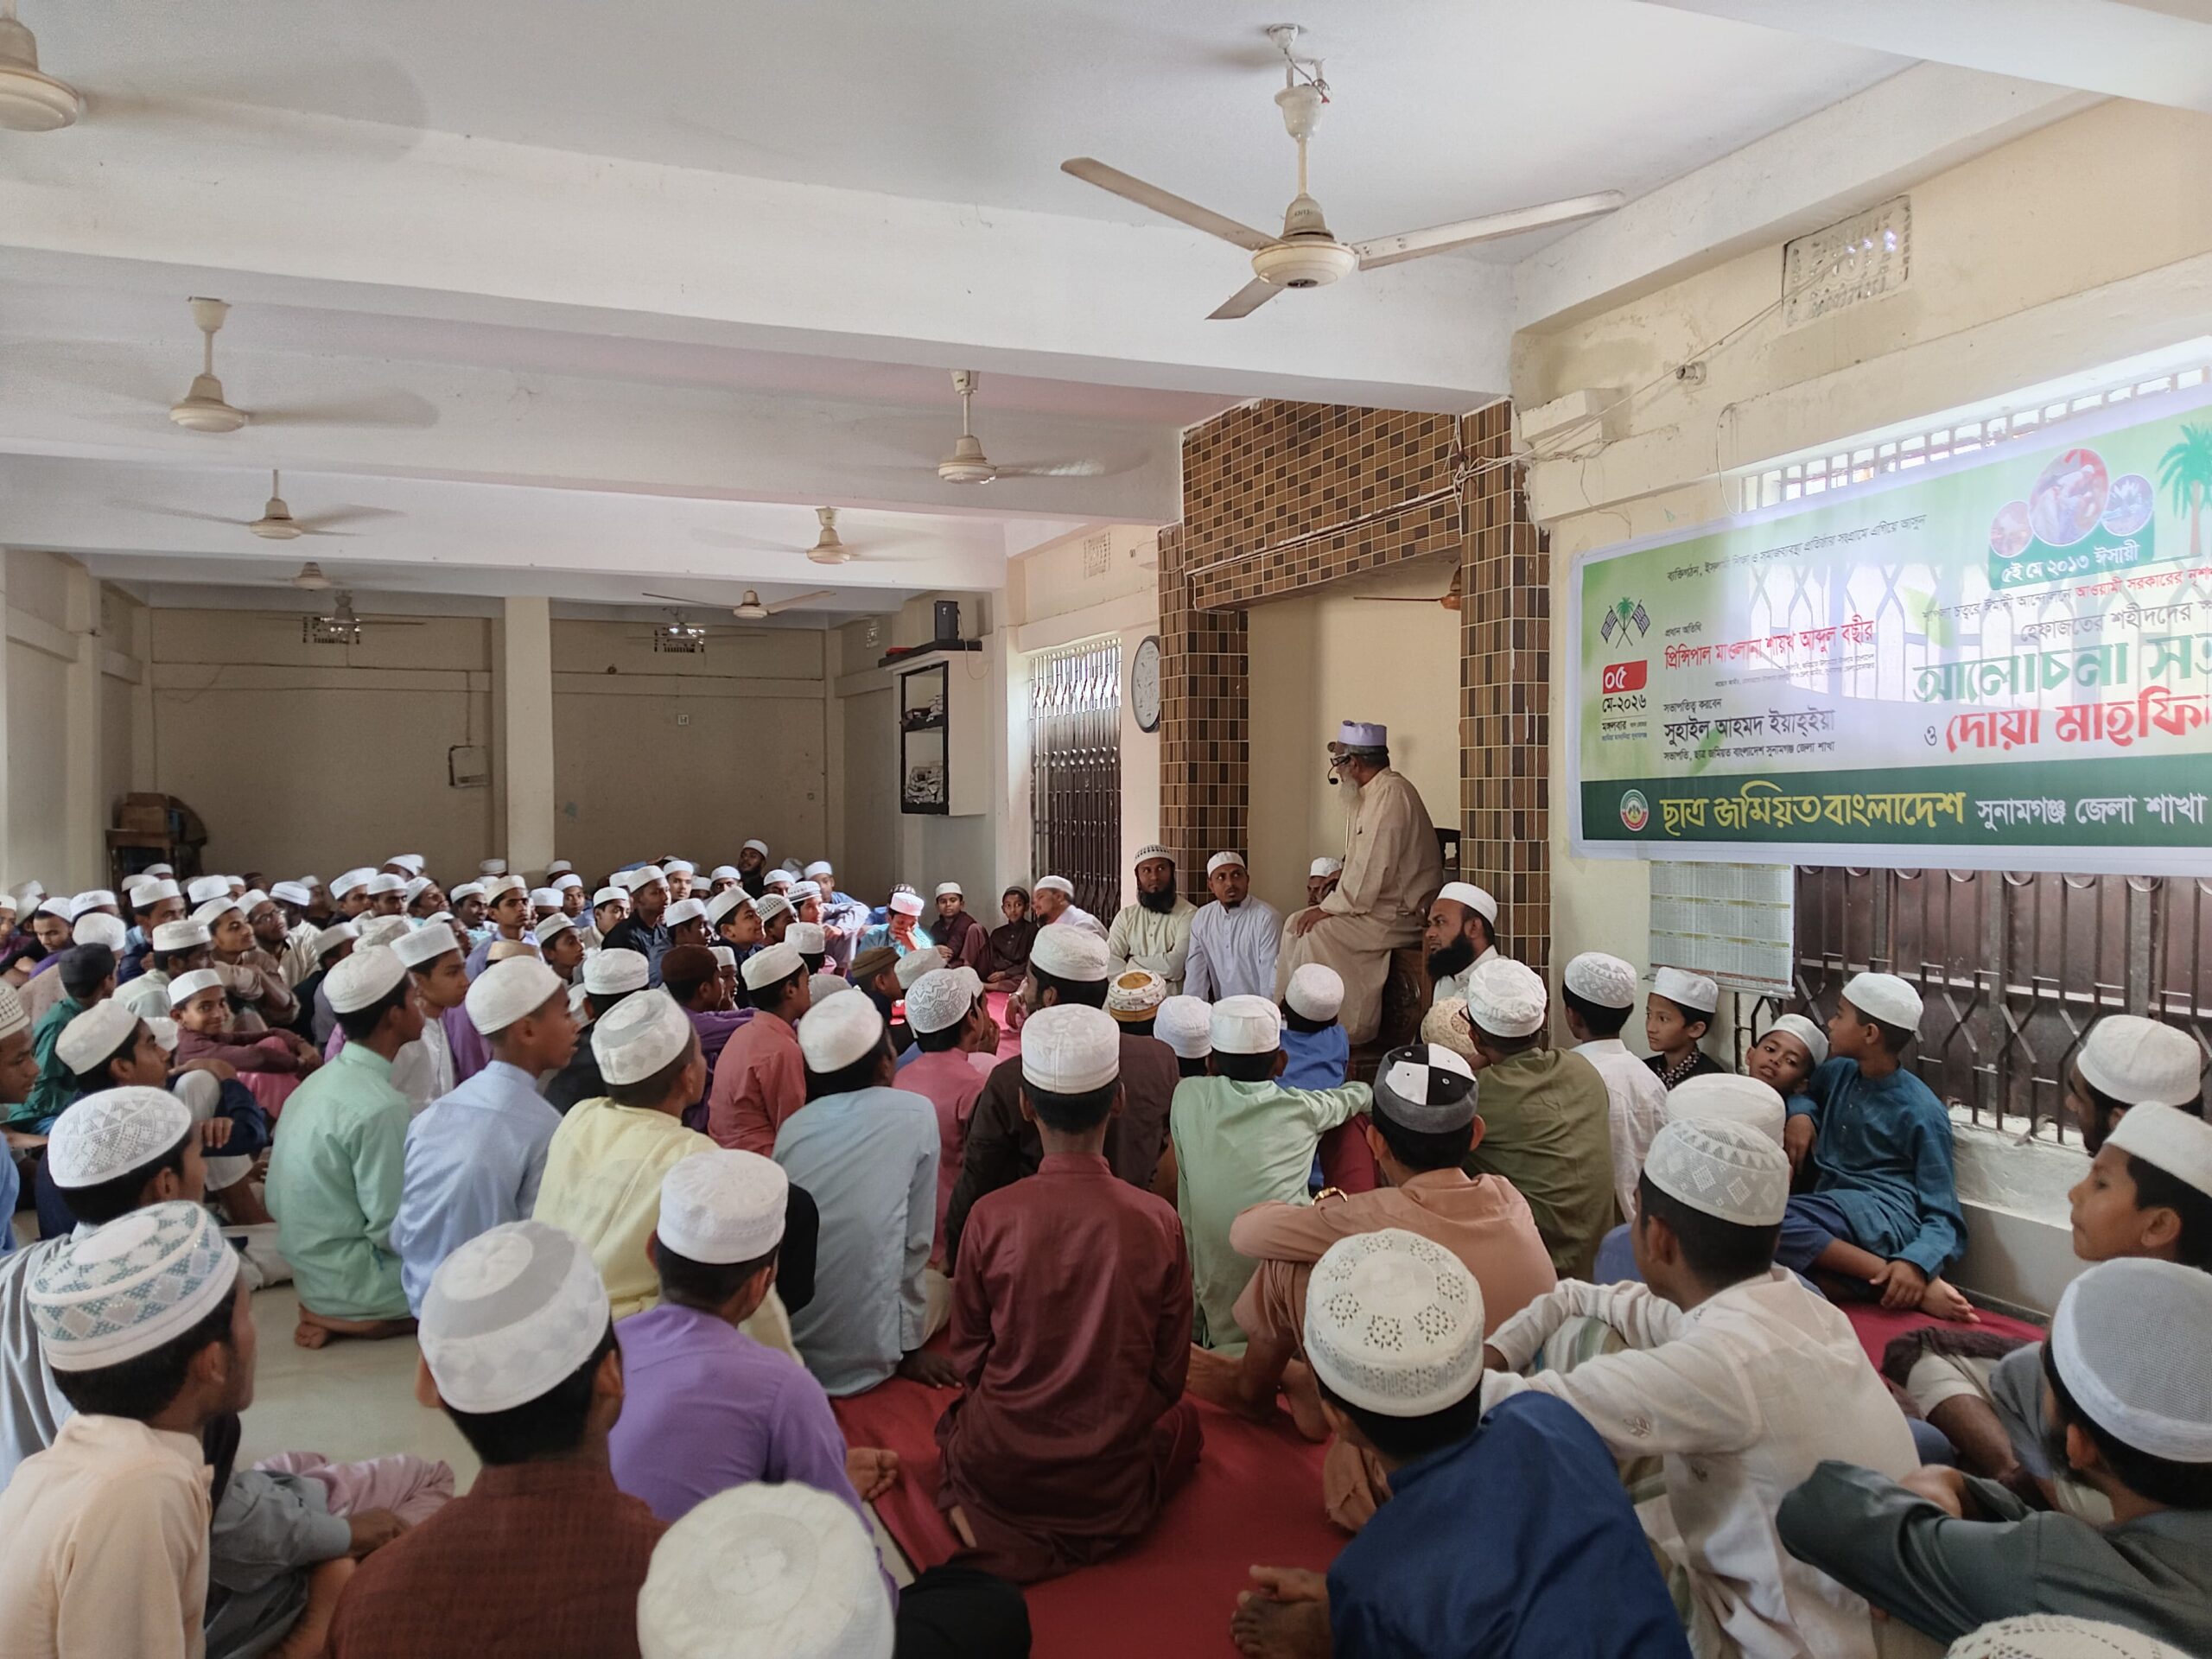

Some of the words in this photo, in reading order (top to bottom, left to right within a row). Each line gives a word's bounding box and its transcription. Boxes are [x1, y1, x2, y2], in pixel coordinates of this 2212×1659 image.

[2025, 562, 2043, 579] মে
[2048, 555, 2089, 575] ২০১৩
[2126, 571, 2183, 591] সরকারের
[2021, 614, 2105, 642] হেফাজতের
[2111, 602, 2193, 629] শহীদদের
[1605, 666, 1628, 690] ০৫
[1912, 642, 2129, 702] আলোচনা
[1602, 694, 1647, 713] মে-২০২৬
[1924, 726, 1937, 747] ও
[1946, 709, 2040, 753] দোয়া
[2055, 685, 2212, 747] মাহফি
[1663, 715, 1711, 747] সুহাইল
[1715, 715, 1764, 738] আহমদ
[1659, 798, 1709, 836] ছাত্র
[1822, 791, 1967, 829] বাংলাদেশ
[1975, 796, 2068, 832] সুনামগঞ্জ
[2075, 794, 2139, 825] জেলা
[2143, 791, 2209, 825] শাখা
